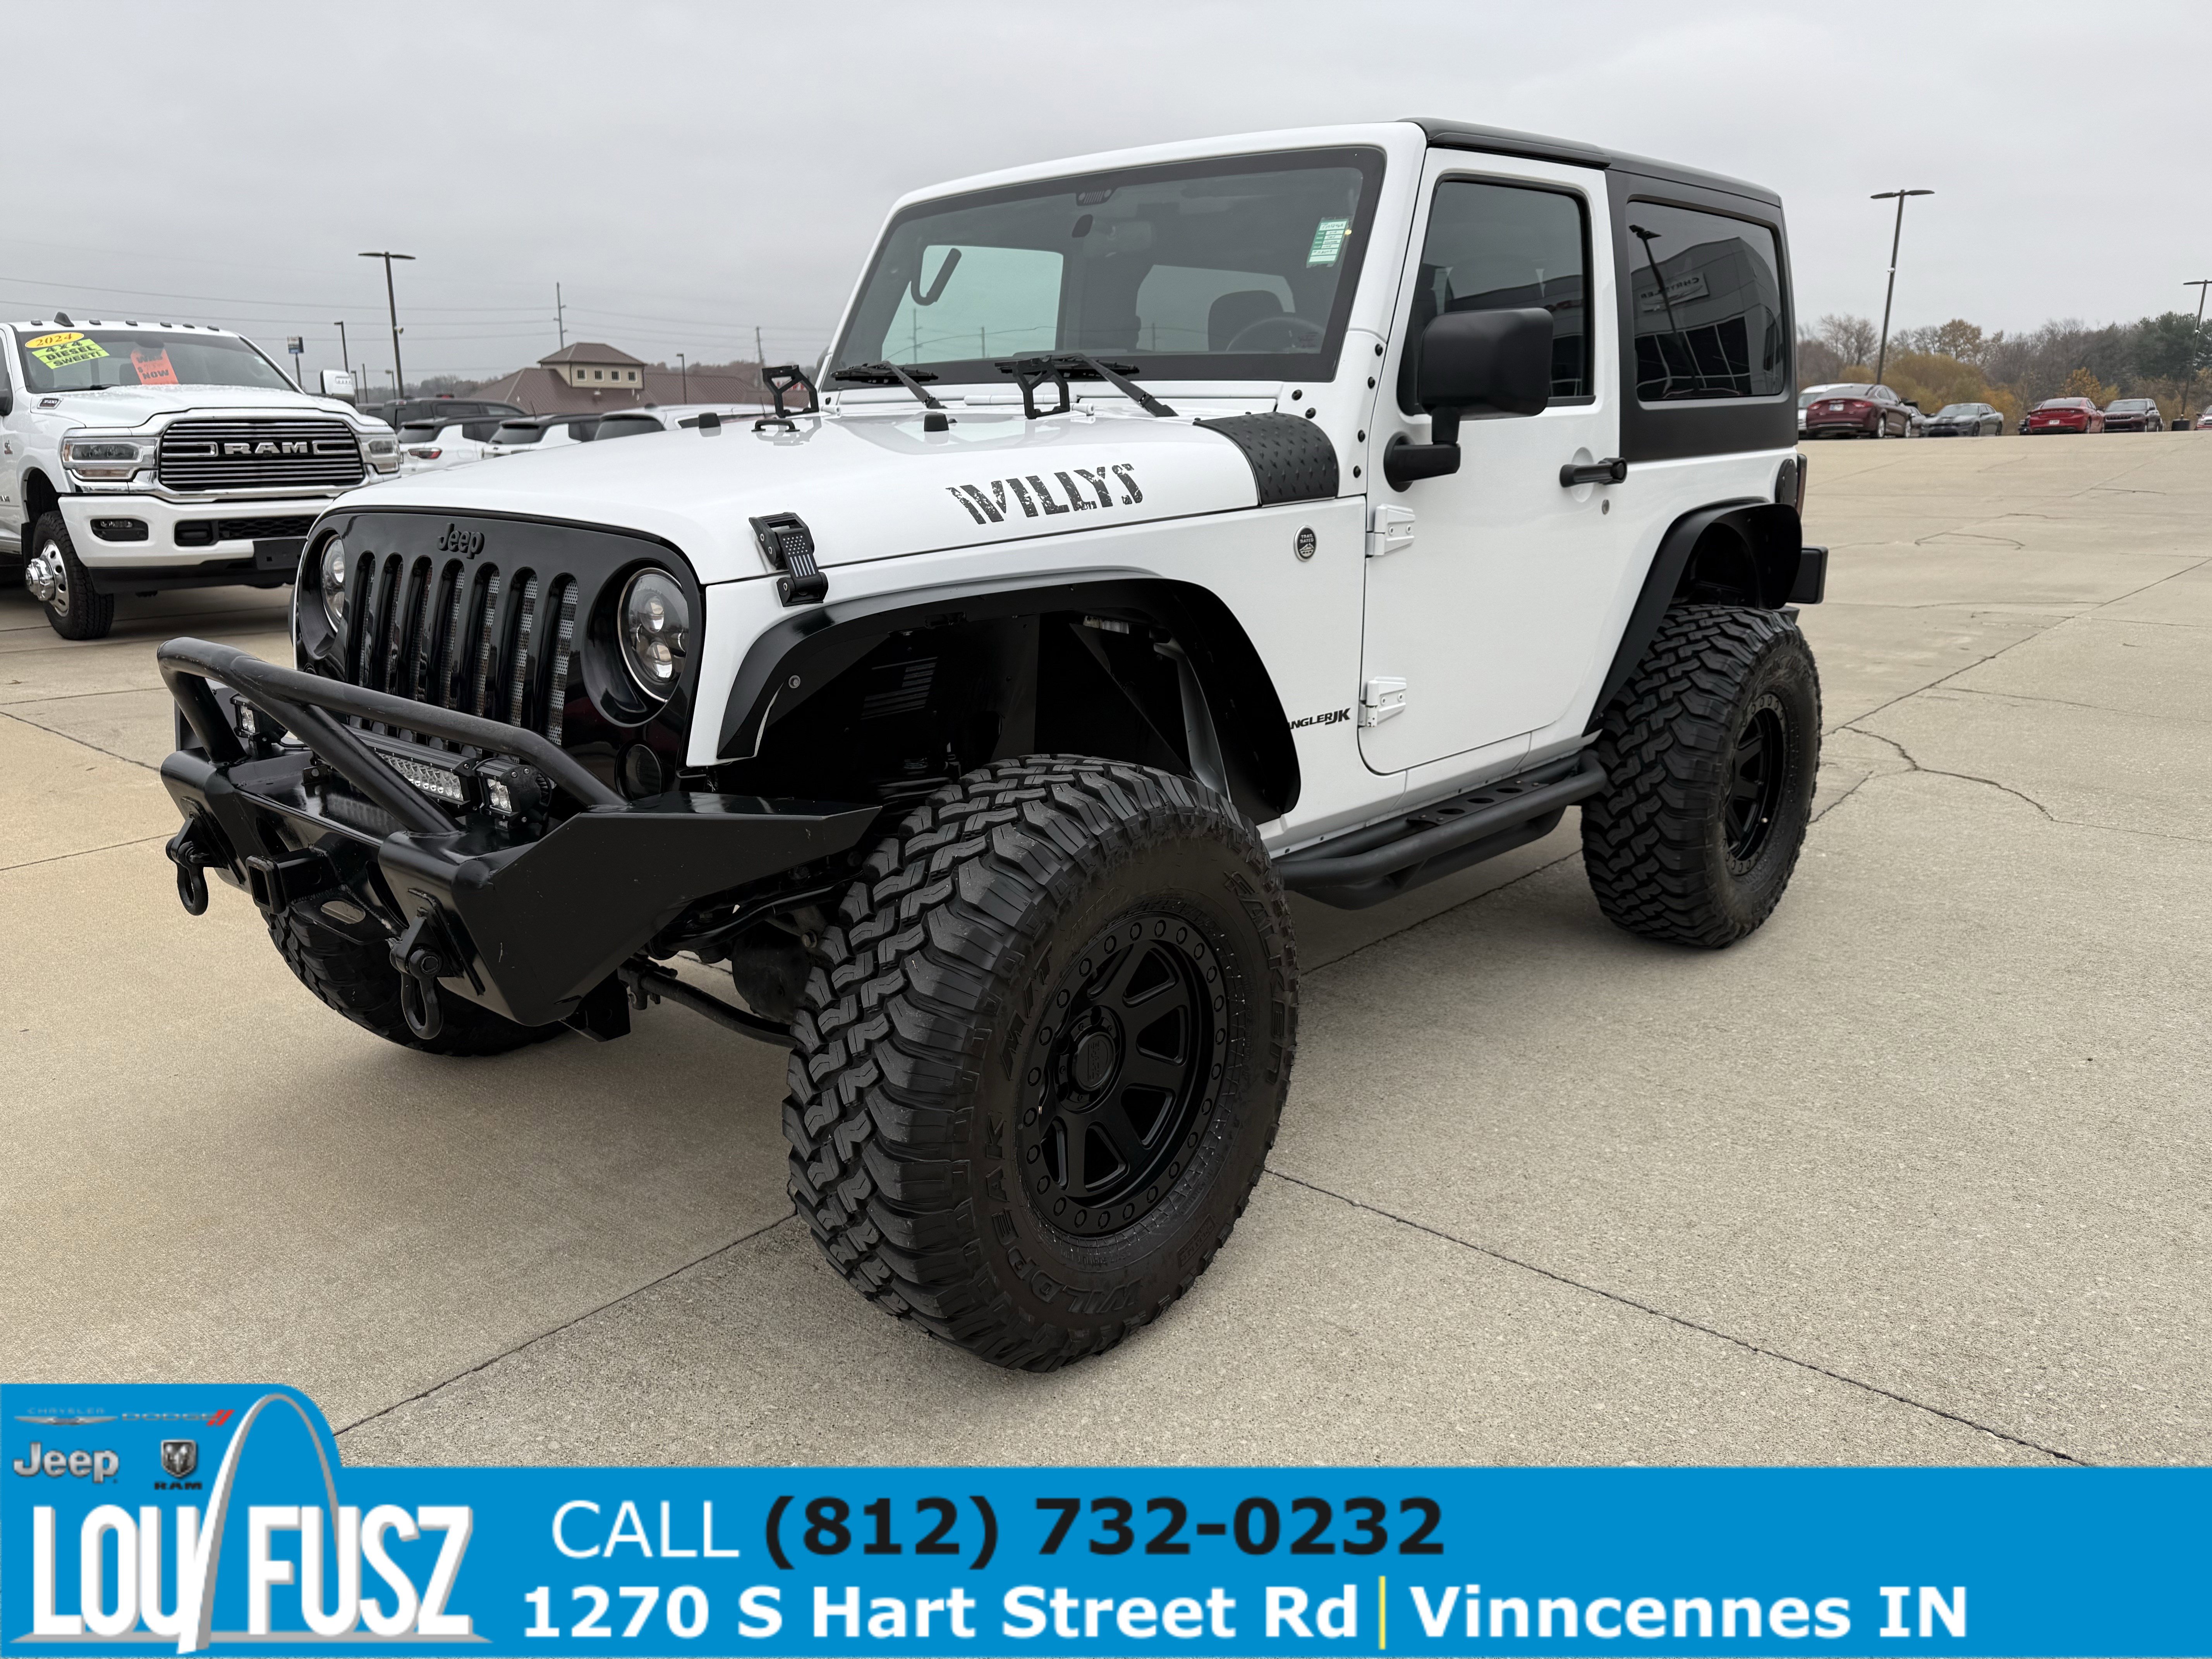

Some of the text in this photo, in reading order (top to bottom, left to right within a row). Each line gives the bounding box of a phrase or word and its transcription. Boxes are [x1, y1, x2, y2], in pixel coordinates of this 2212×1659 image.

[36, 333, 72, 346] 2024
[46, 345, 95, 361] DIESEL
[143, 370, 169, 379] NOW
[224, 442, 308, 455] RAM
[945, 463, 1144, 525] WILLYS
[437, 523, 485, 560] Jeep
[985, 1109, 1143, 1314] WILDPEAK
